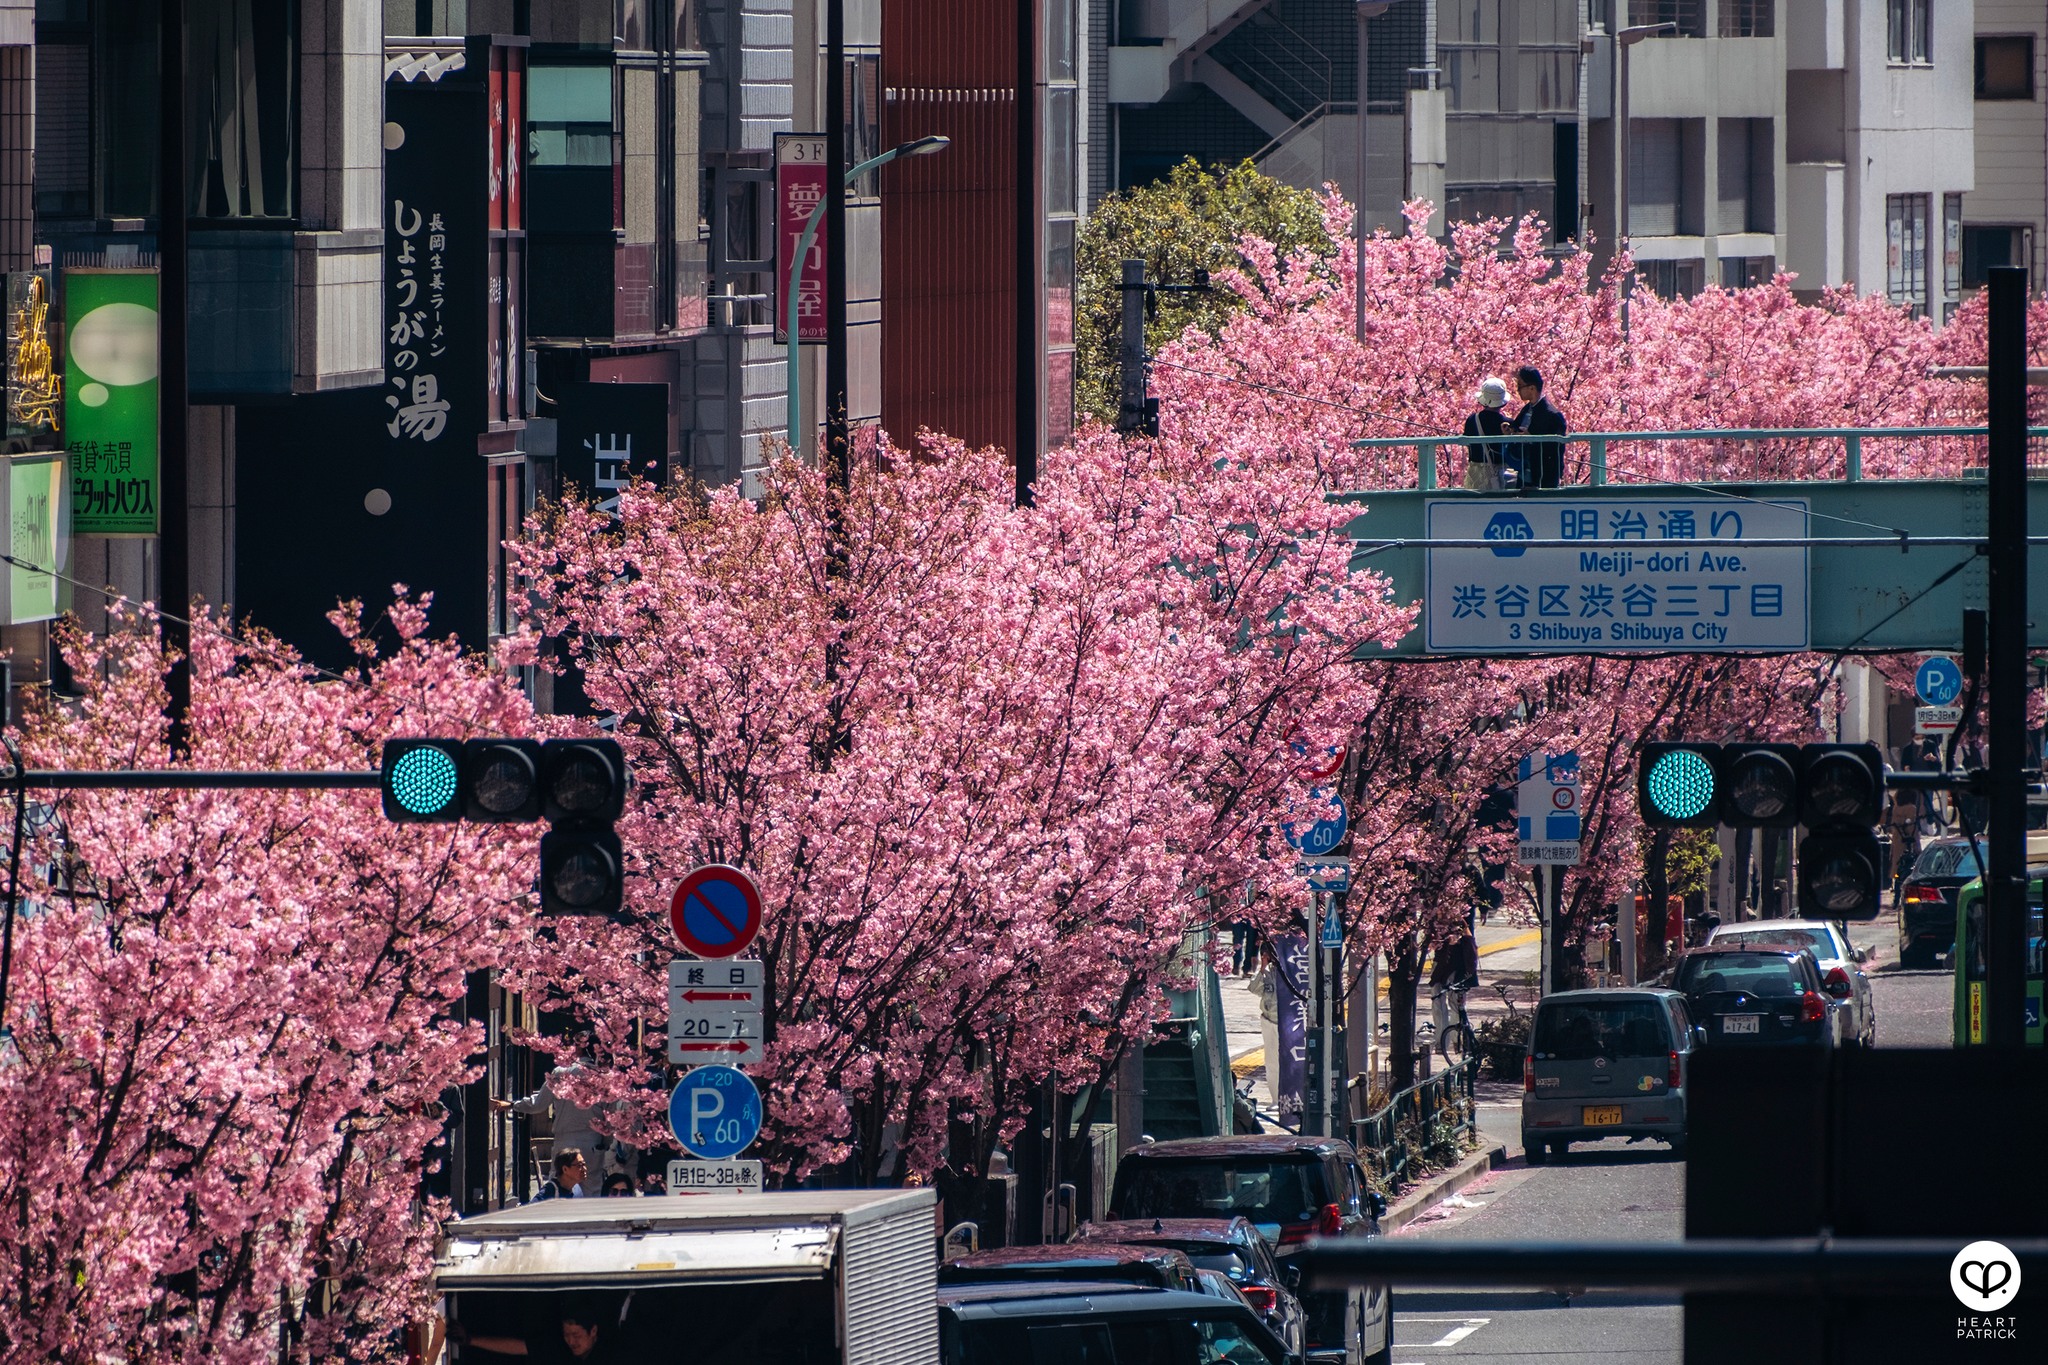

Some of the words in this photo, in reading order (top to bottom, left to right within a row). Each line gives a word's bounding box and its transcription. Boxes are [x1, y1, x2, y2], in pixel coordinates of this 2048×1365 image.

[428, 213, 446, 357] 長岡生姜ラーメン
[384, 199, 452, 442] しょうがの湯
[1490, 523, 1528, 540] 305
[1560, 508, 1744, 541] 明治通り
[1579, 551, 1689, 577] Meiji-dori
[1698, 551, 1747, 572] Ave.
[1451, 583, 1783, 619] 渋谷区渋谷三丁目
[1509, 623, 1522, 640] 3
[1528, 622, 1602, 643] Shibuya
[1610, 622, 1684, 643] Shibuya
[1691, 622, 1728, 643] City
[1926, 670, 1945, 694] P
[1313, 827, 1333, 847] 60
[699, 1072, 733, 1087] 7-20
[690, 1087, 725, 1144] P
[714, 1118, 740, 1144] 60
